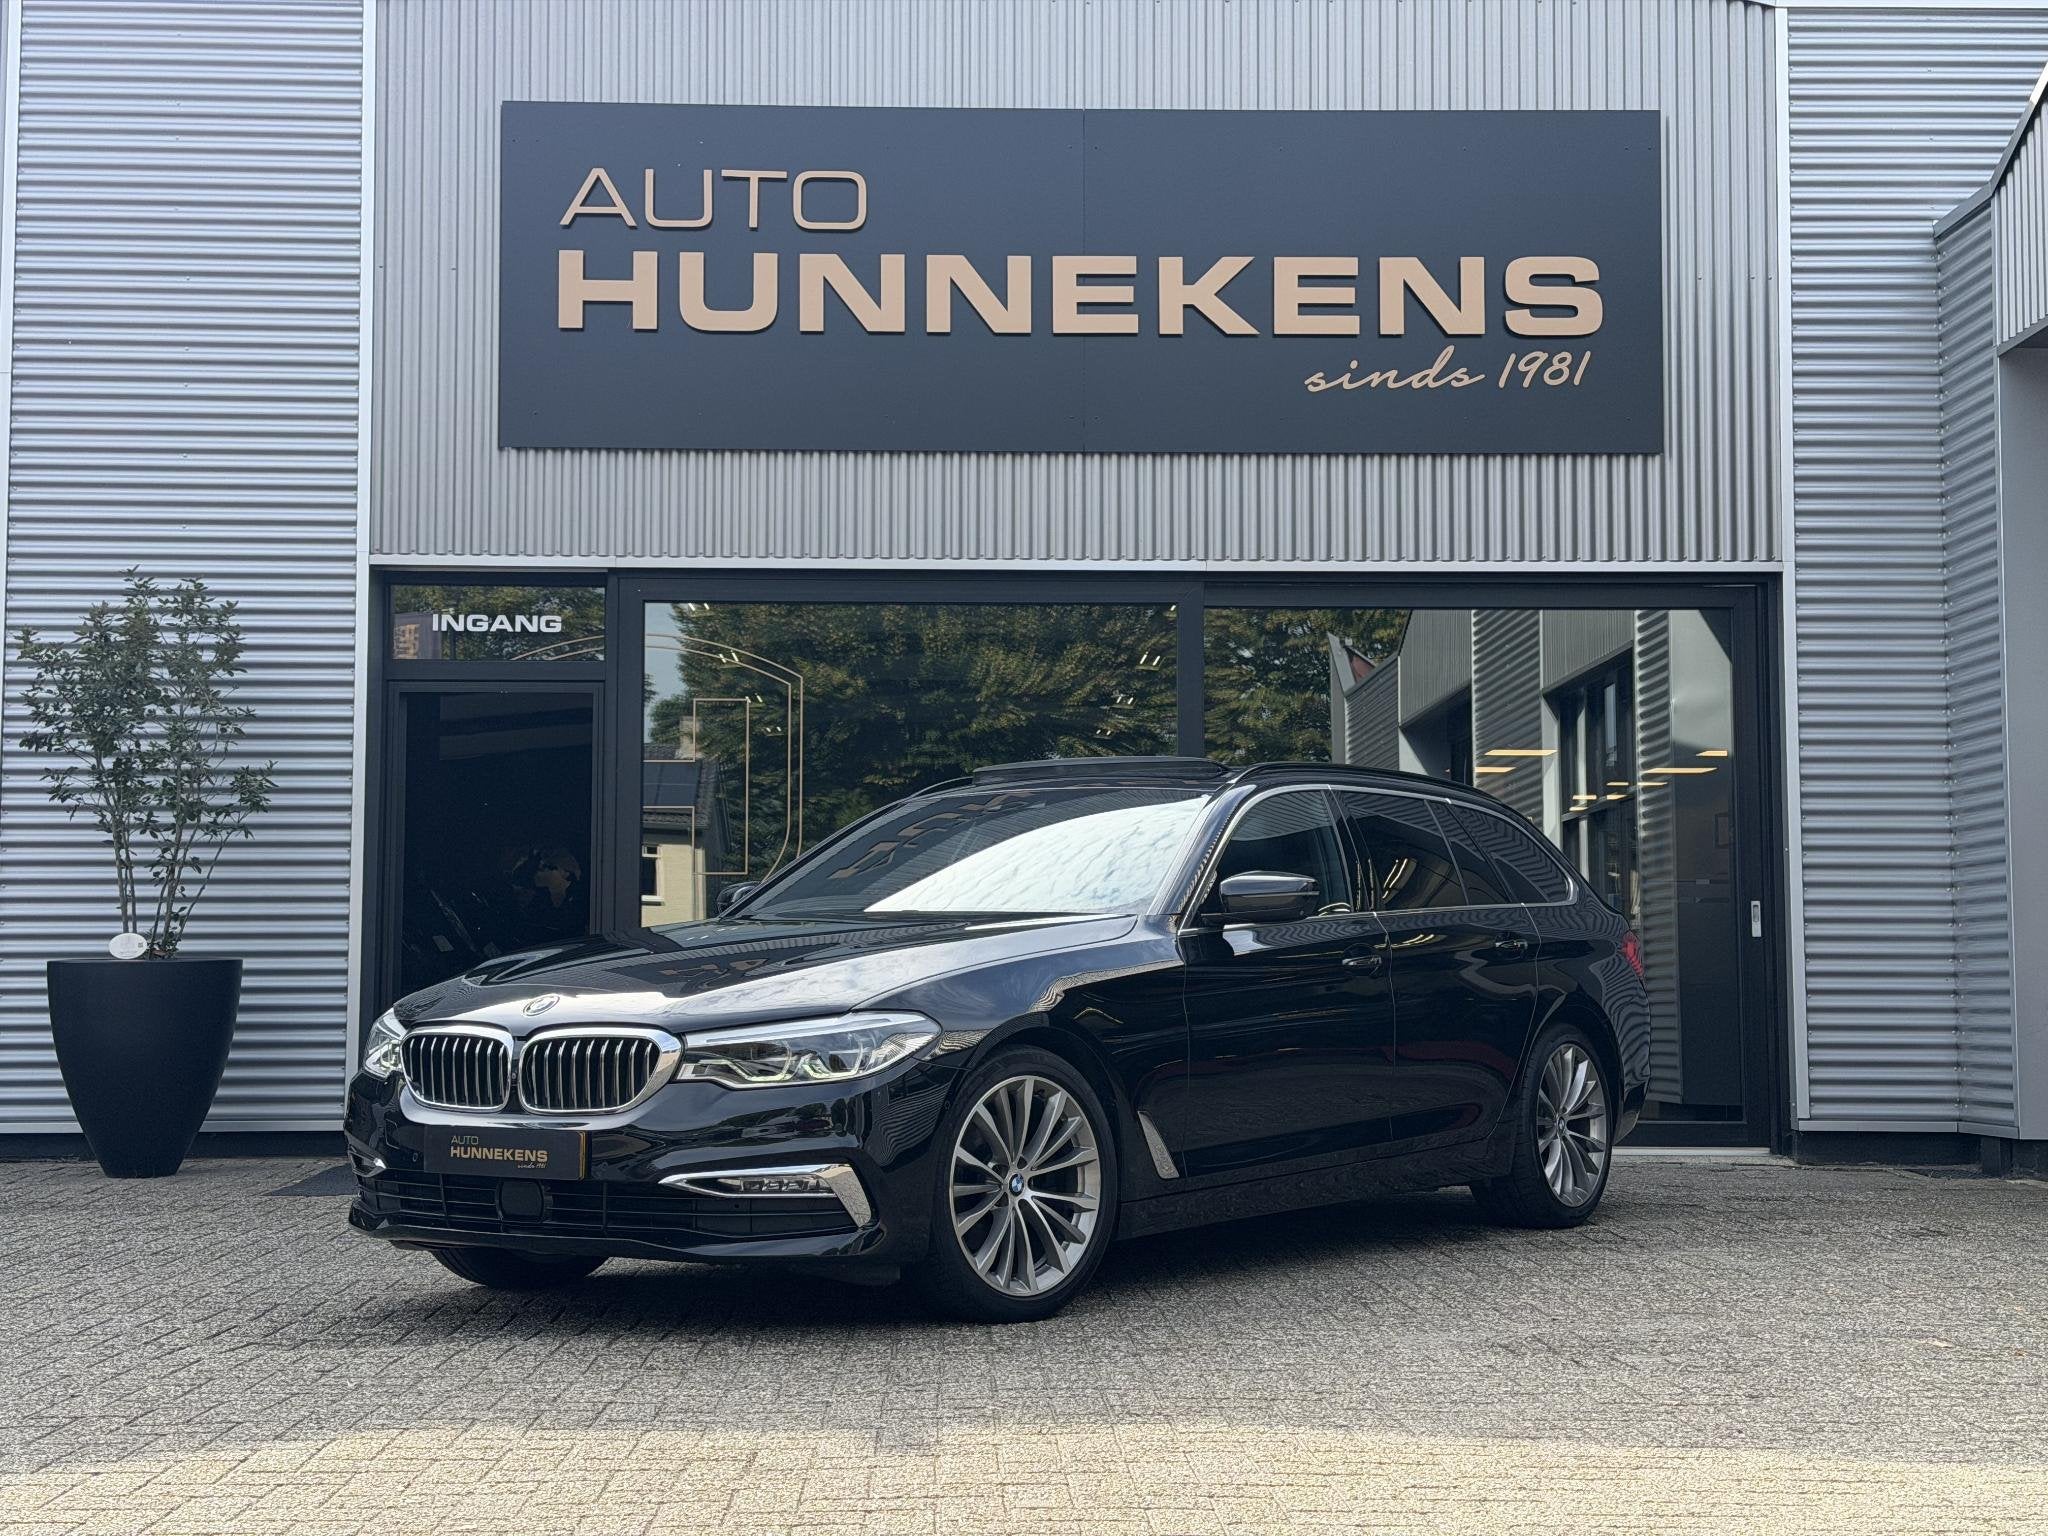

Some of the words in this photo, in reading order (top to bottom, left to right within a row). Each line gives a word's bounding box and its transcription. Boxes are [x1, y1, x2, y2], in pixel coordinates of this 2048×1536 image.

[560, 168, 867, 231] AUTO
[558, 250, 1603, 336] HUNNEKENS
[1305, 345, 1484, 393] sinds
[1498, 351, 1592, 389] 1981
[432, 614, 562, 633] INGANG
[450, 1146, 548, 1162] HUNNEKENS
[451, 1135, 479, 1145] AUTO
